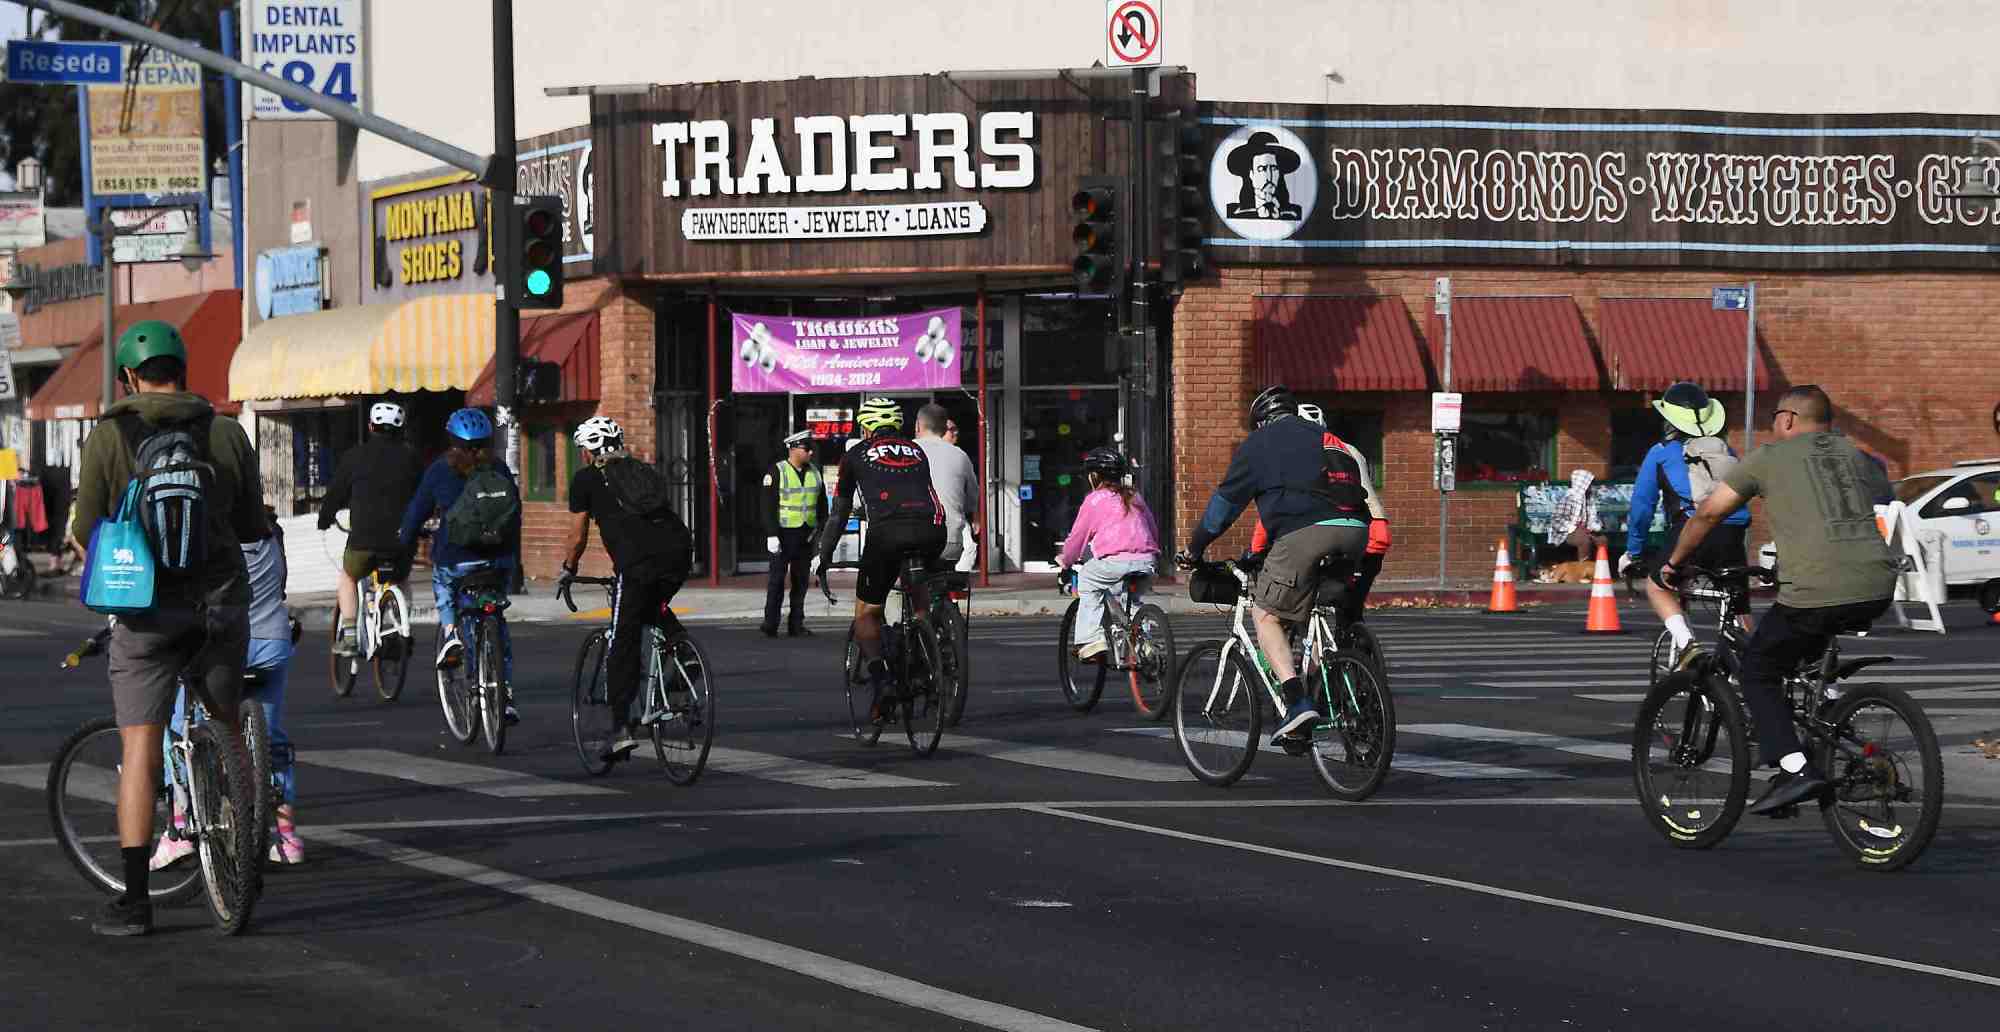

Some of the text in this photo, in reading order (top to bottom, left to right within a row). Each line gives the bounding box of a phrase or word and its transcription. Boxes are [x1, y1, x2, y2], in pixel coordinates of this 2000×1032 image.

[267, 6, 343, 26] DENTAL
[253, 33, 356, 54] IMPLANTS
[20, 50, 111, 73] Reseda
[652, 112, 1035, 197] TRADERS
[1333, 149, 1627, 223] DIAMONDS
[1648, 153, 1896, 226] WATCHES
[385, 190, 475, 240] MONTANA
[692, 207, 970, 234] PAWNBROKER JEWELRY LOANS
[401, 240, 461, 284] SHOES
[792, 318, 900, 337] TRADERS
[795, 338, 826, 350] LOAN
[842, 336, 900, 350] JEWELRY
